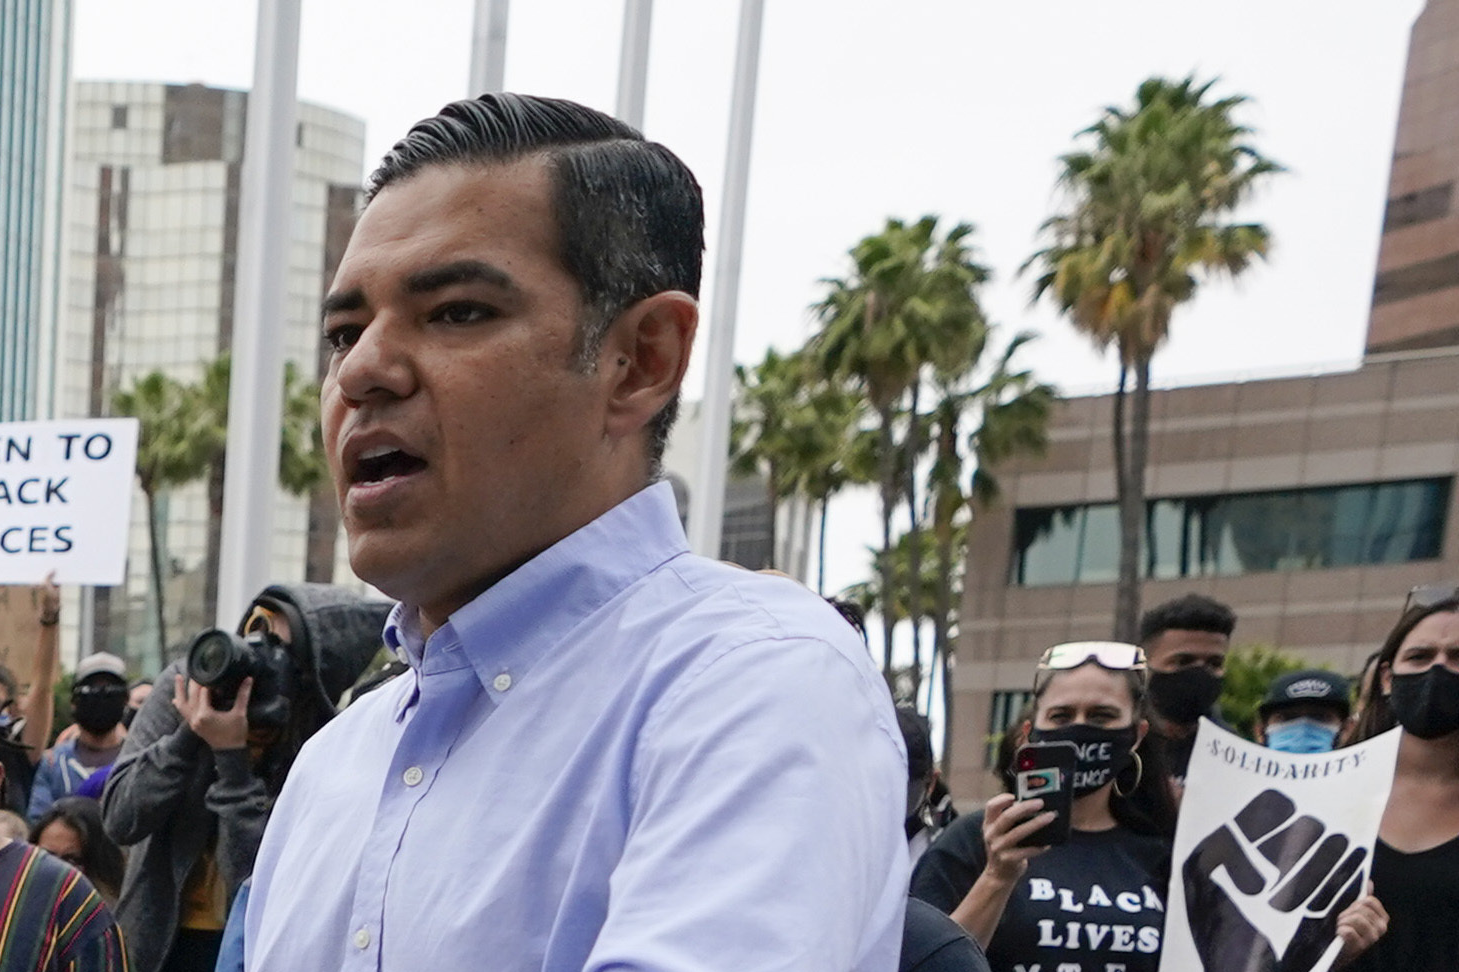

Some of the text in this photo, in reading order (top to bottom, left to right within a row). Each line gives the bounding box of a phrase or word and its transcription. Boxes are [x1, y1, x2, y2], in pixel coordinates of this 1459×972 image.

[58, 433, 113, 461] TO
[1209, 739, 1365, 780] SOLIDARITY
[1028, 877, 1164, 913] BLACK
[1037, 919, 1160, 953] LIVES
